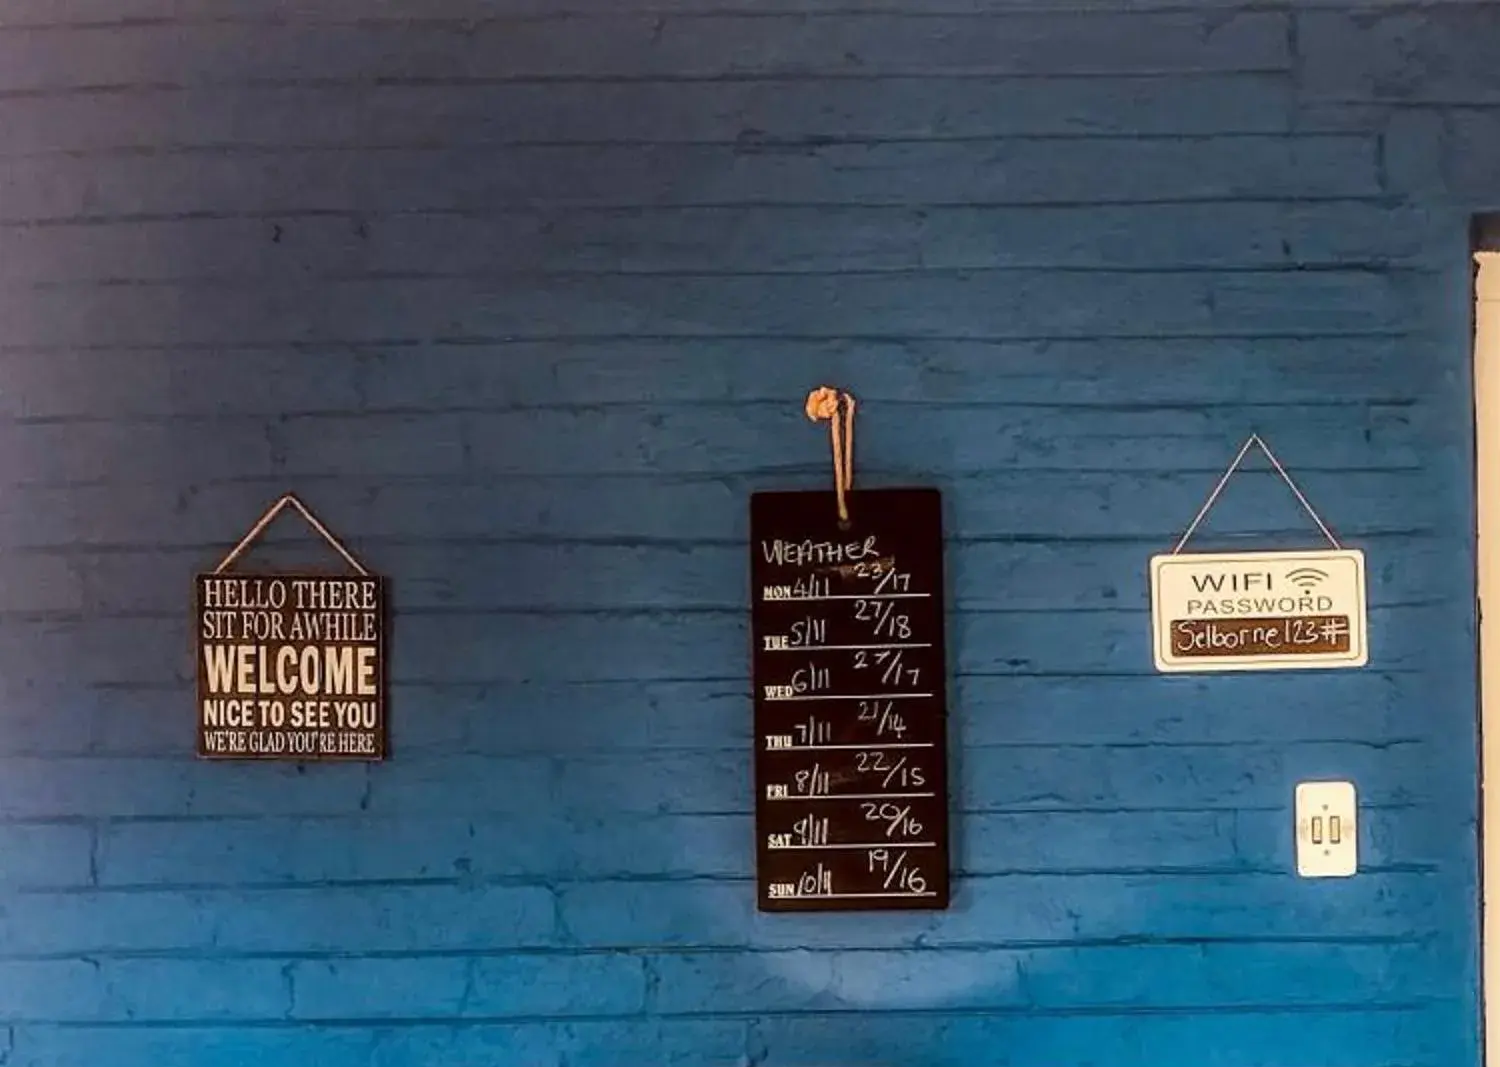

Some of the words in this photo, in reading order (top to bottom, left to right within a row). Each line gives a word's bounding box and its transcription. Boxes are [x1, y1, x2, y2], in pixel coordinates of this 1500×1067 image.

[762, 536, 880, 566] WEATHER
[204, 579, 287, 608] HELLO
[292, 581, 376, 609] THERE
[763, 585, 791, 600] MON
[792, 573, 830, 599] 4/11
[855, 561, 911, 595] 23/17
[1191, 573, 1273, 593] WIFI
[763, 635, 789, 650] TUE
[791, 616, 826, 647] 5/11
[855, 600, 912, 639] 27/18
[1187, 596, 1333, 615] PASSWORD
[203, 611, 237, 639] SIT
[242, 612, 285, 640] FOR
[290, 613, 377, 641] AWHILE
[204, 645, 376, 695] WELCOME
[764, 685, 793, 699] WED
[791, 661, 830, 693] 6/11
[853, 650, 920, 686] 27/17
[204, 700, 254, 727] NICE
[258, 701, 285, 727] TO
[291, 702, 330, 728] SEE
[334, 702, 376, 729] YOU
[765, 735, 792, 749] THU
[794, 715, 831, 748] 7/11
[857, 701, 906, 739] 21/14
[204, 730, 247, 752] WE'RE
[250, 732, 285, 752] GLAD
[288, 732, 335, 753] YOU'RE
[338, 733, 375, 753] HERE
[766, 784, 789, 799] FRI
[795, 763, 829, 798] 8/11
[856, 752, 925, 788] 22/15
[768, 833, 792, 848] SAT
[793, 813, 829, 847] 9/11
[860, 803, 923, 837] 20/16
[768, 884, 795, 897] SUN
[868, 849, 926, 893] 19/16
